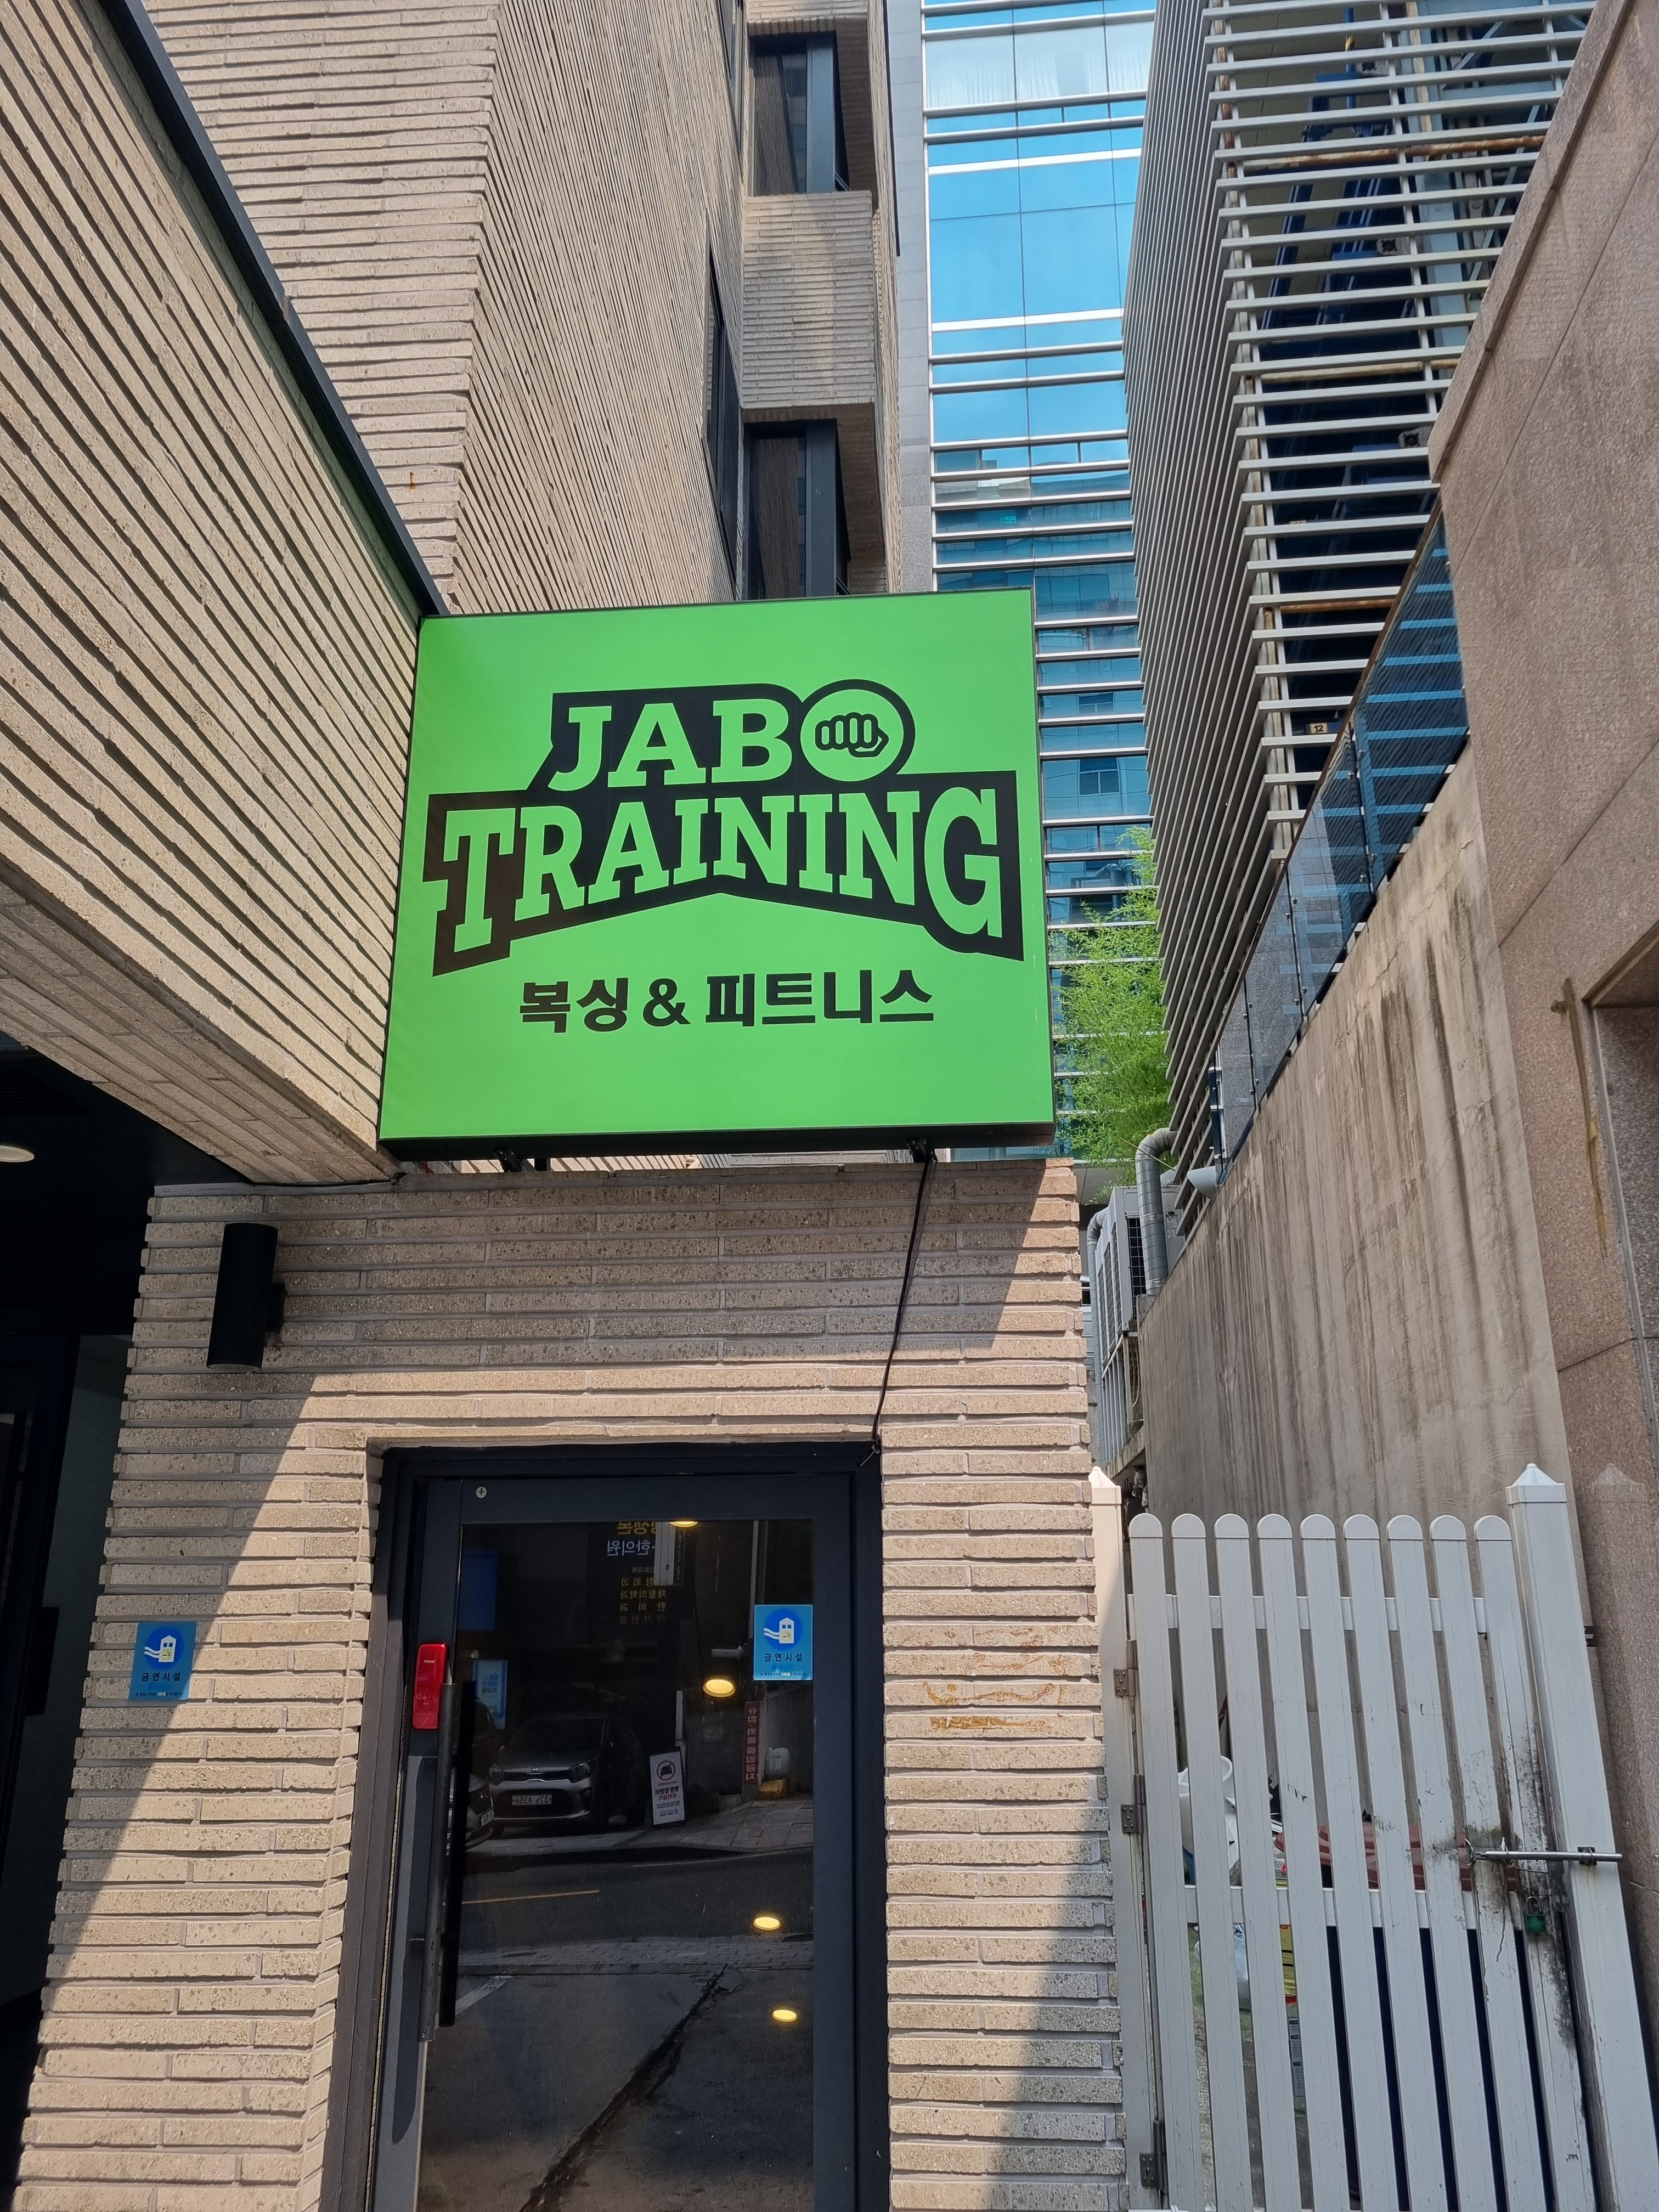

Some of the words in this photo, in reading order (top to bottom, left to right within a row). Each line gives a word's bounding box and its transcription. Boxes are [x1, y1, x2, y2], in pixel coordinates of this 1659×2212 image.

[1313, 724, 1324, 733] 12
[443, 786, 1003, 953] TRAINING
[519, 977, 629, 1034] 복싱
[642, 978, 691, 1027] &
[706, 969, 934, 1027] 피트니스
[764, 1652, 803, 1662] 금연시설
[142, 1672, 181, 1682] 금연시설
